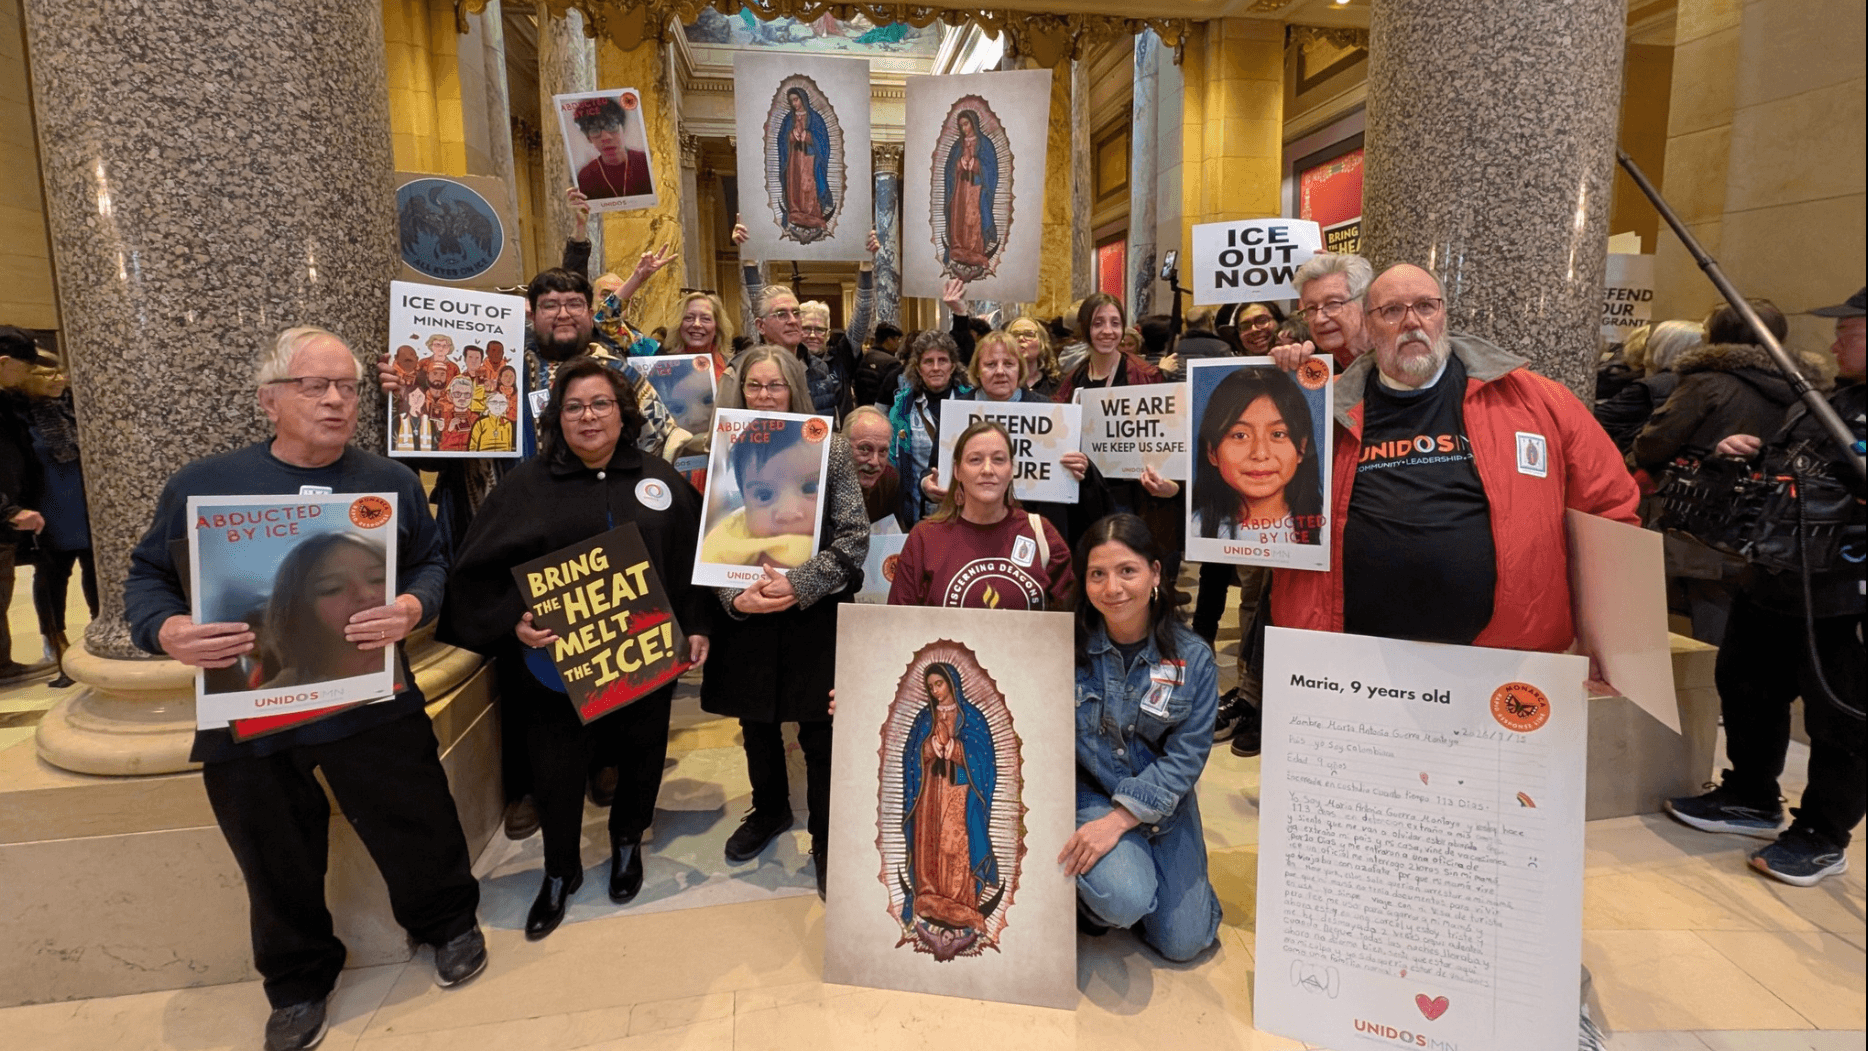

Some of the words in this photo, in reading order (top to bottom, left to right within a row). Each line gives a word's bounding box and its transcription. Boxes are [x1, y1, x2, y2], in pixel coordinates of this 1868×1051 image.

[1227, 226, 1289, 247] ICE
[1328, 226, 1359, 244] BRING
[1218, 244, 1298, 268] OUT
[414, 259, 432, 273] ALL
[433, 266, 459, 276] EYES
[461, 266, 474, 276] ON
[474, 258, 489, 272] ICE
[1214, 265, 1302, 289] NOW
[402, 295, 435, 311] ICE
[440, 300, 482, 316] OUT
[485, 306, 512, 319] OF
[413, 315, 504, 335] MINNESOTA
[1101, 398, 1131, 416] WE
[1135, 396, 1176, 415] ARE
[716, 419, 785, 433] ABDUCTED
[1106, 419, 1165, 438] LIGHT.
[730, 433, 747, 444] BY
[750, 432, 771, 443] ICE
[1092, 442, 1108, 453] WE
[1110, 442, 1136, 453] KEEP
[1138, 442, 1153, 452] US
[1155, 441, 1187, 453] SAFE.
[1358, 460, 1401, 473] OMMUNITY
[195, 504, 322, 530] ABDUCTED
[1240, 514, 1327, 531] ABDUCTED
[226, 526, 256, 543] BY
[265, 522, 300, 538] ICE
[1260, 533, 1279, 544] BY
[1284, 530, 1310, 544] ICE
[1224, 546, 1270, 557] UNIDOS
[526, 547, 609, 598] BRING
[533, 597, 561, 616] THE
[562, 560, 650, 625] HEAT
[949, 563, 995, 605] ISCERNING
[999, 563, 1040, 604] DEACONS
[554, 610, 631, 663] MELT
[563, 662, 594, 682] THE
[591, 621, 674, 687] ICE!
[255, 691, 319, 708] UNIDOS
[1290, 674, 1345, 694] Maria,
[1350, 680, 1362, 694] 9
[1366, 685, 1416, 700] years
[1422, 689, 1451, 704] old
[1506, 684, 1547, 708] MONARCA
[1354, 1018, 1427, 1047] UNIDOS
